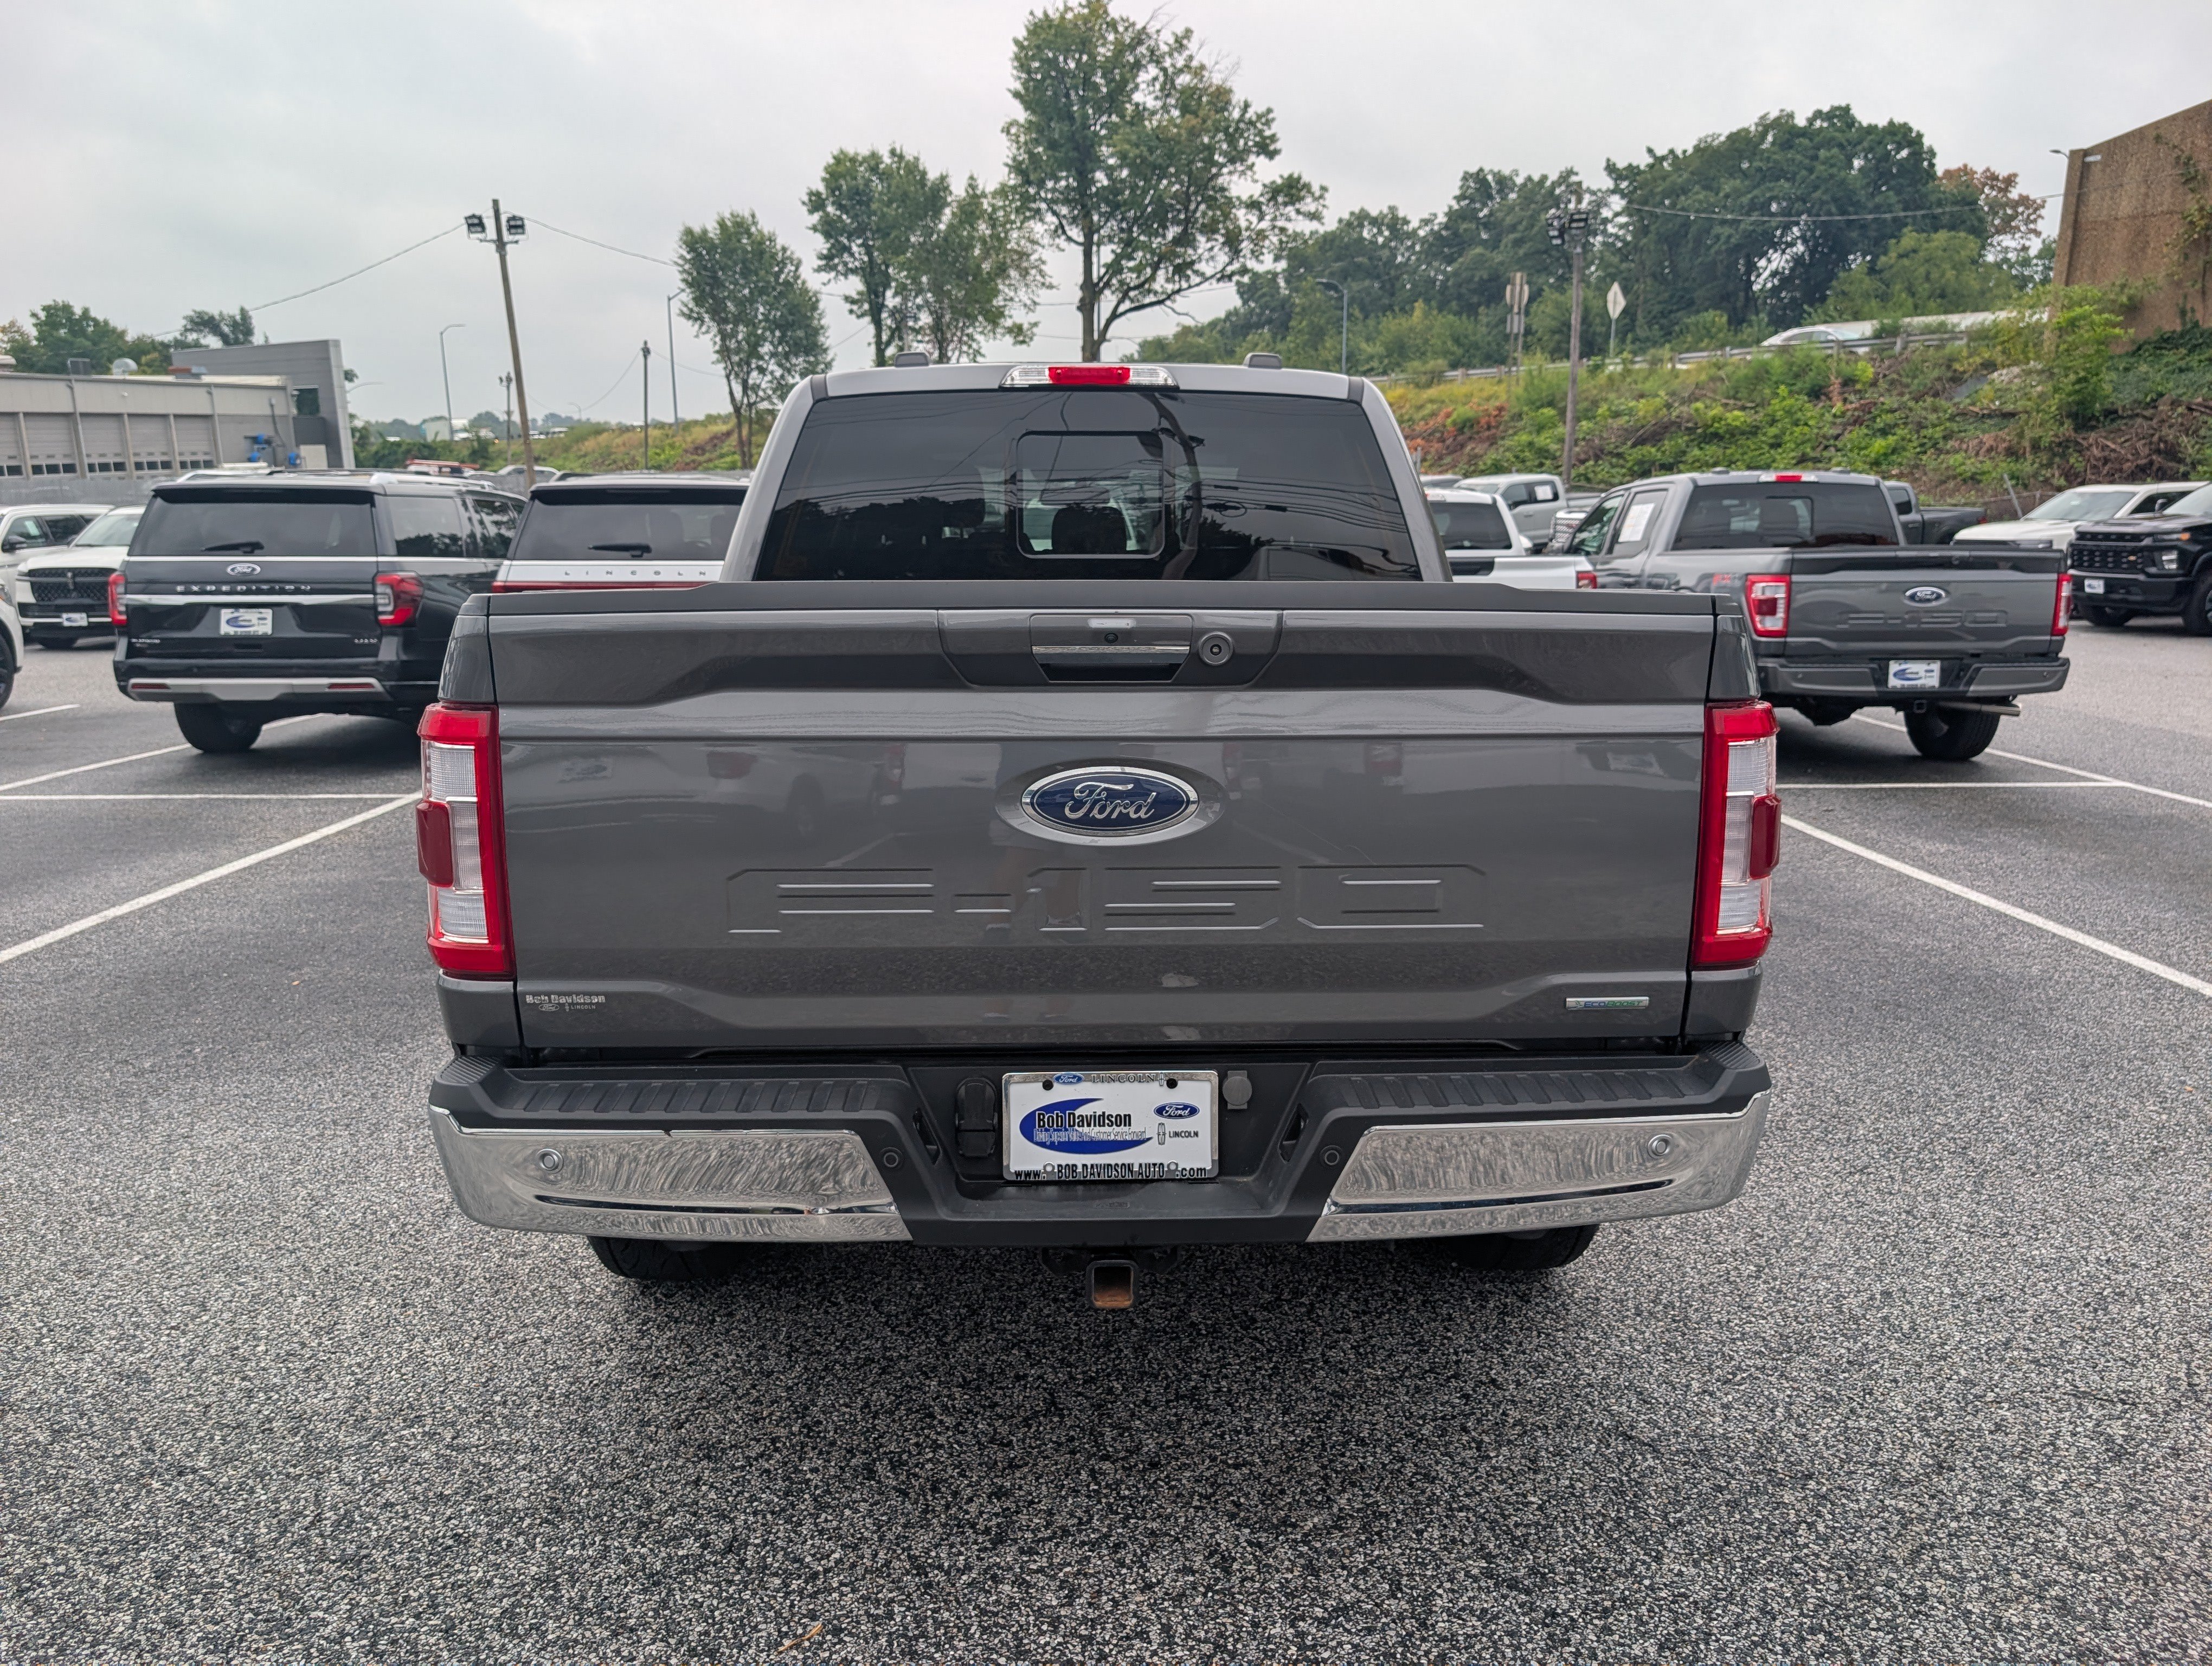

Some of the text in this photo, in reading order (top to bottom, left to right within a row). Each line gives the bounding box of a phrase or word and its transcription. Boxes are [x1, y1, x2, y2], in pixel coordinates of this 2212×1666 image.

[1064, 781, 1157, 819] Ford
[525, 994, 606, 1003] Bob Davidson
[1059, 1073, 1156, 1083] Ford LINCOLN
[1163, 1105, 1191, 1116] Ford
[1037, 1111, 1132, 1129] Bob Davidson
[1091, 1128, 1112, 1140] Customer
[1112, 1127, 1128, 1140] Service
[1128, 1127, 1146, 1140] Forward
[1057, 1163, 1078, 1180] BOB
[1082, 1162, 1134, 1179] DAVIDSON
[1139, 1162, 1165, 1178] AUTO
